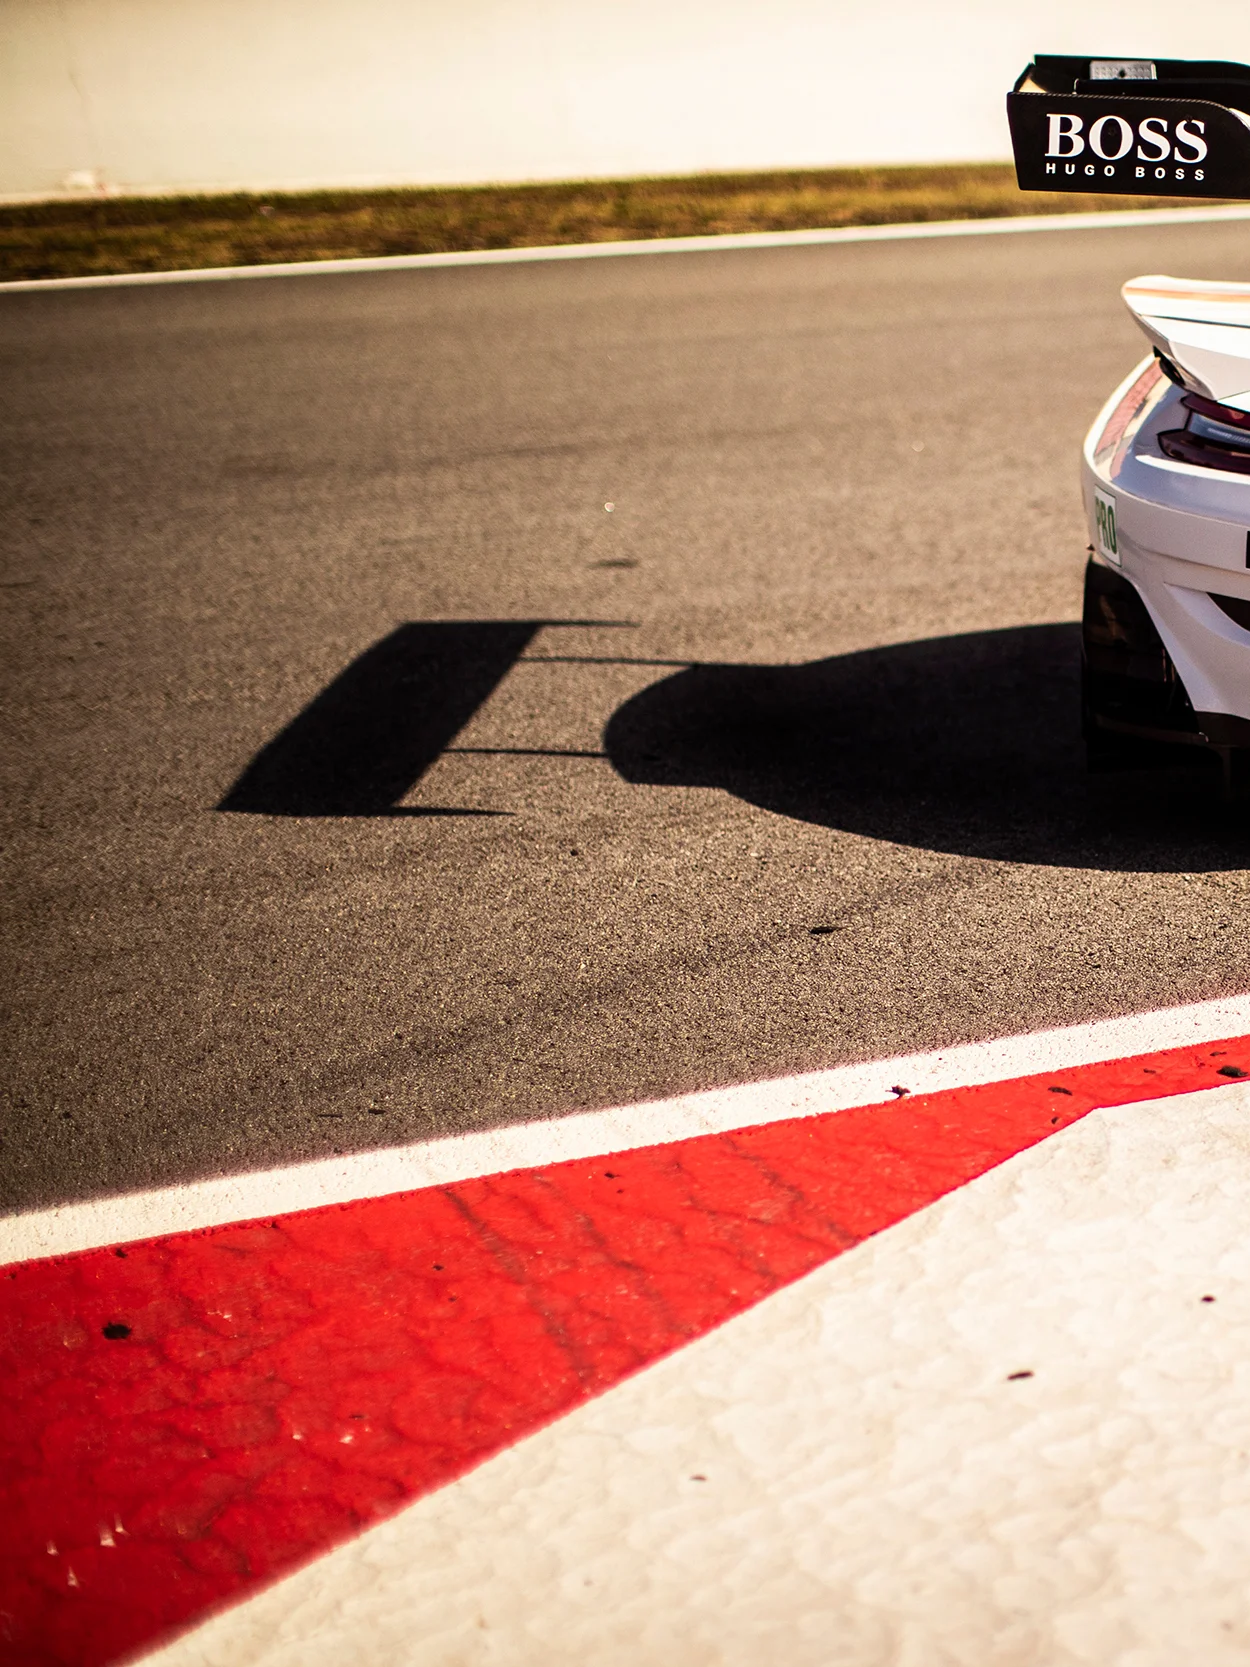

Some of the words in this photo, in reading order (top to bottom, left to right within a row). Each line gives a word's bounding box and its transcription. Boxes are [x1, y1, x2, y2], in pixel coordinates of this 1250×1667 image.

[1045, 114, 1208, 164] BOSS
[1046, 163, 1115, 176] HUGO
[1135, 167, 1205, 181] BOSS
